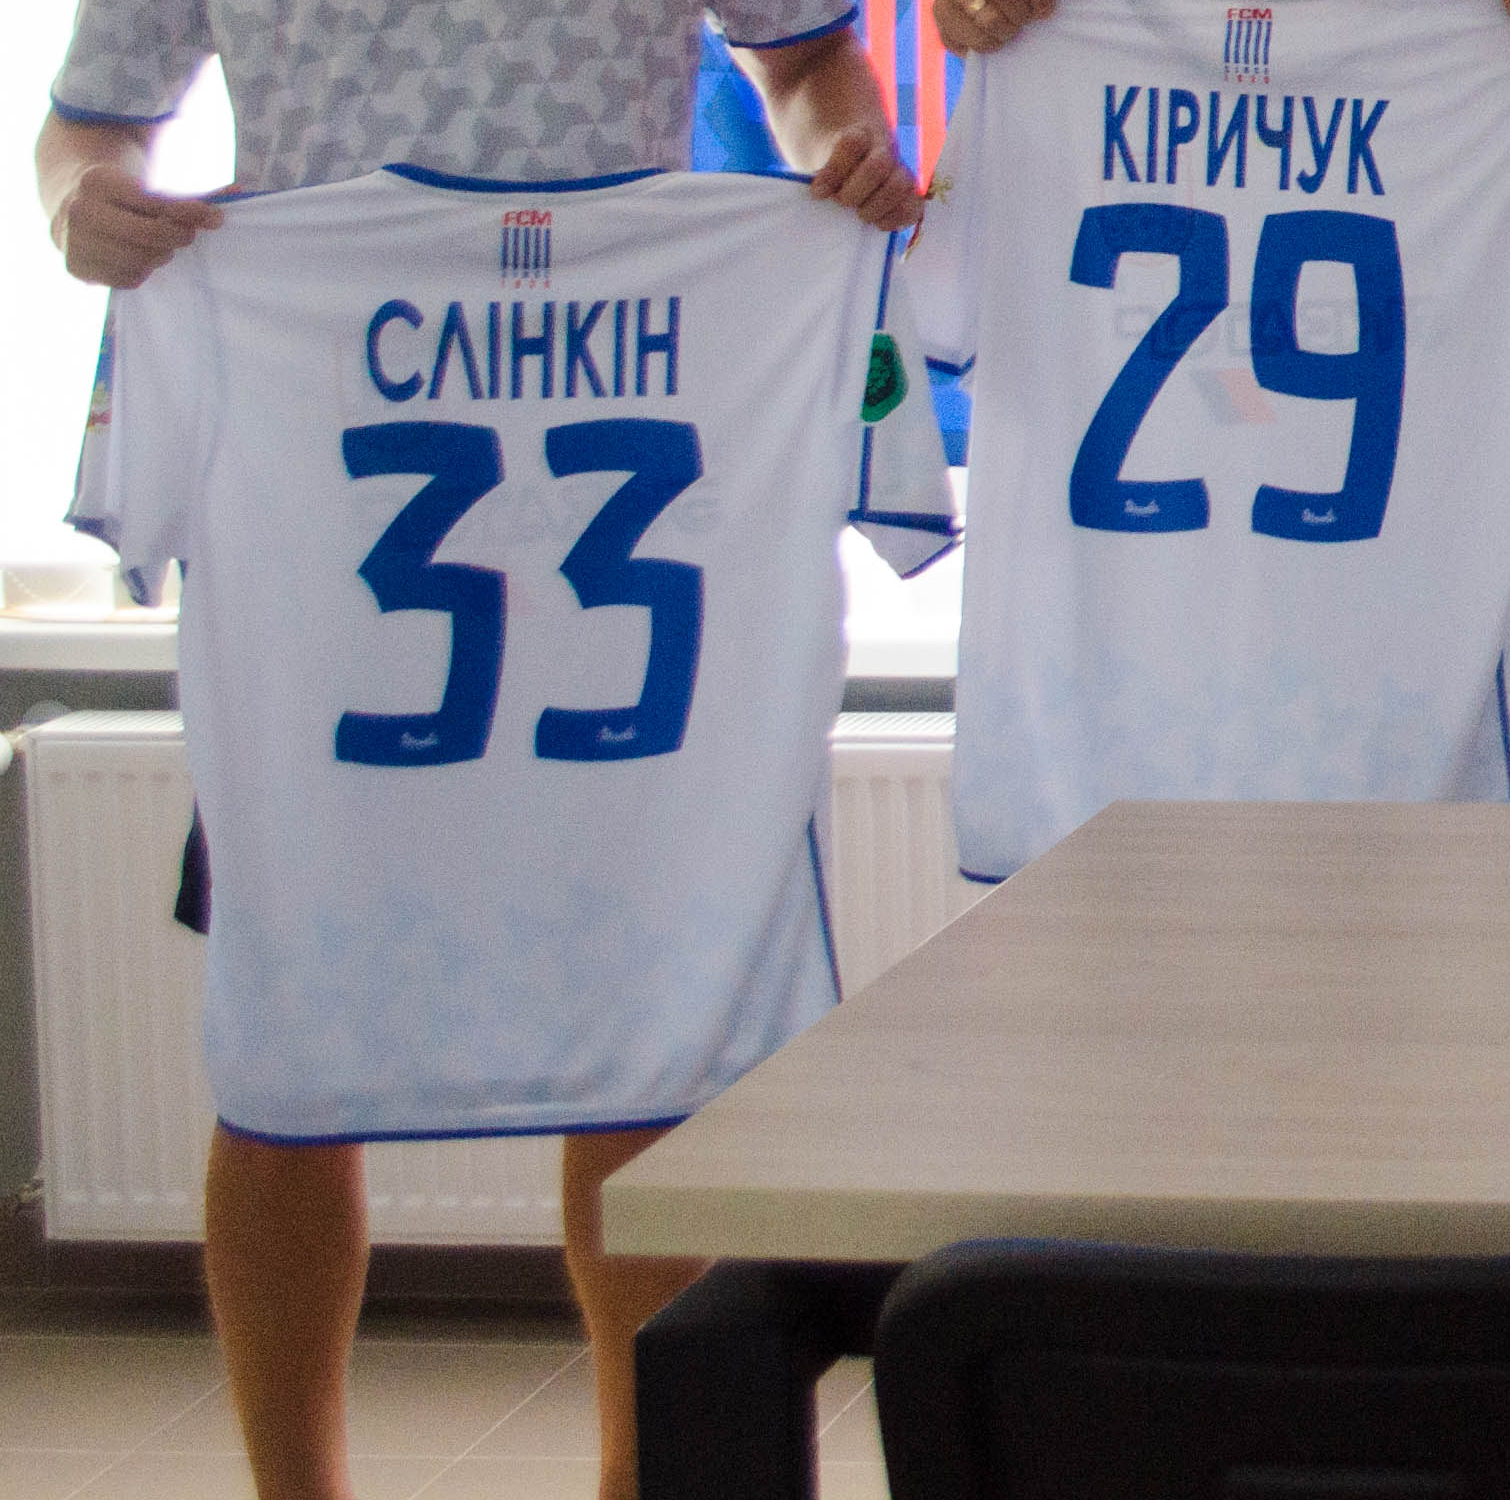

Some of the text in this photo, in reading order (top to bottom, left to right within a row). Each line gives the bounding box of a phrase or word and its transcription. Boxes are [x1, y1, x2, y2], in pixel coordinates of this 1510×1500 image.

[1226, 7, 1273, 19] FCM
[1102, 84, 1388, 196] КІРИЧУК
[502, 209, 552, 226] FCM
[364, 296, 680, 403] СЛІНКІН
[1068, 203, 1407, 544] 29
[333, 417, 704, 769] 33
